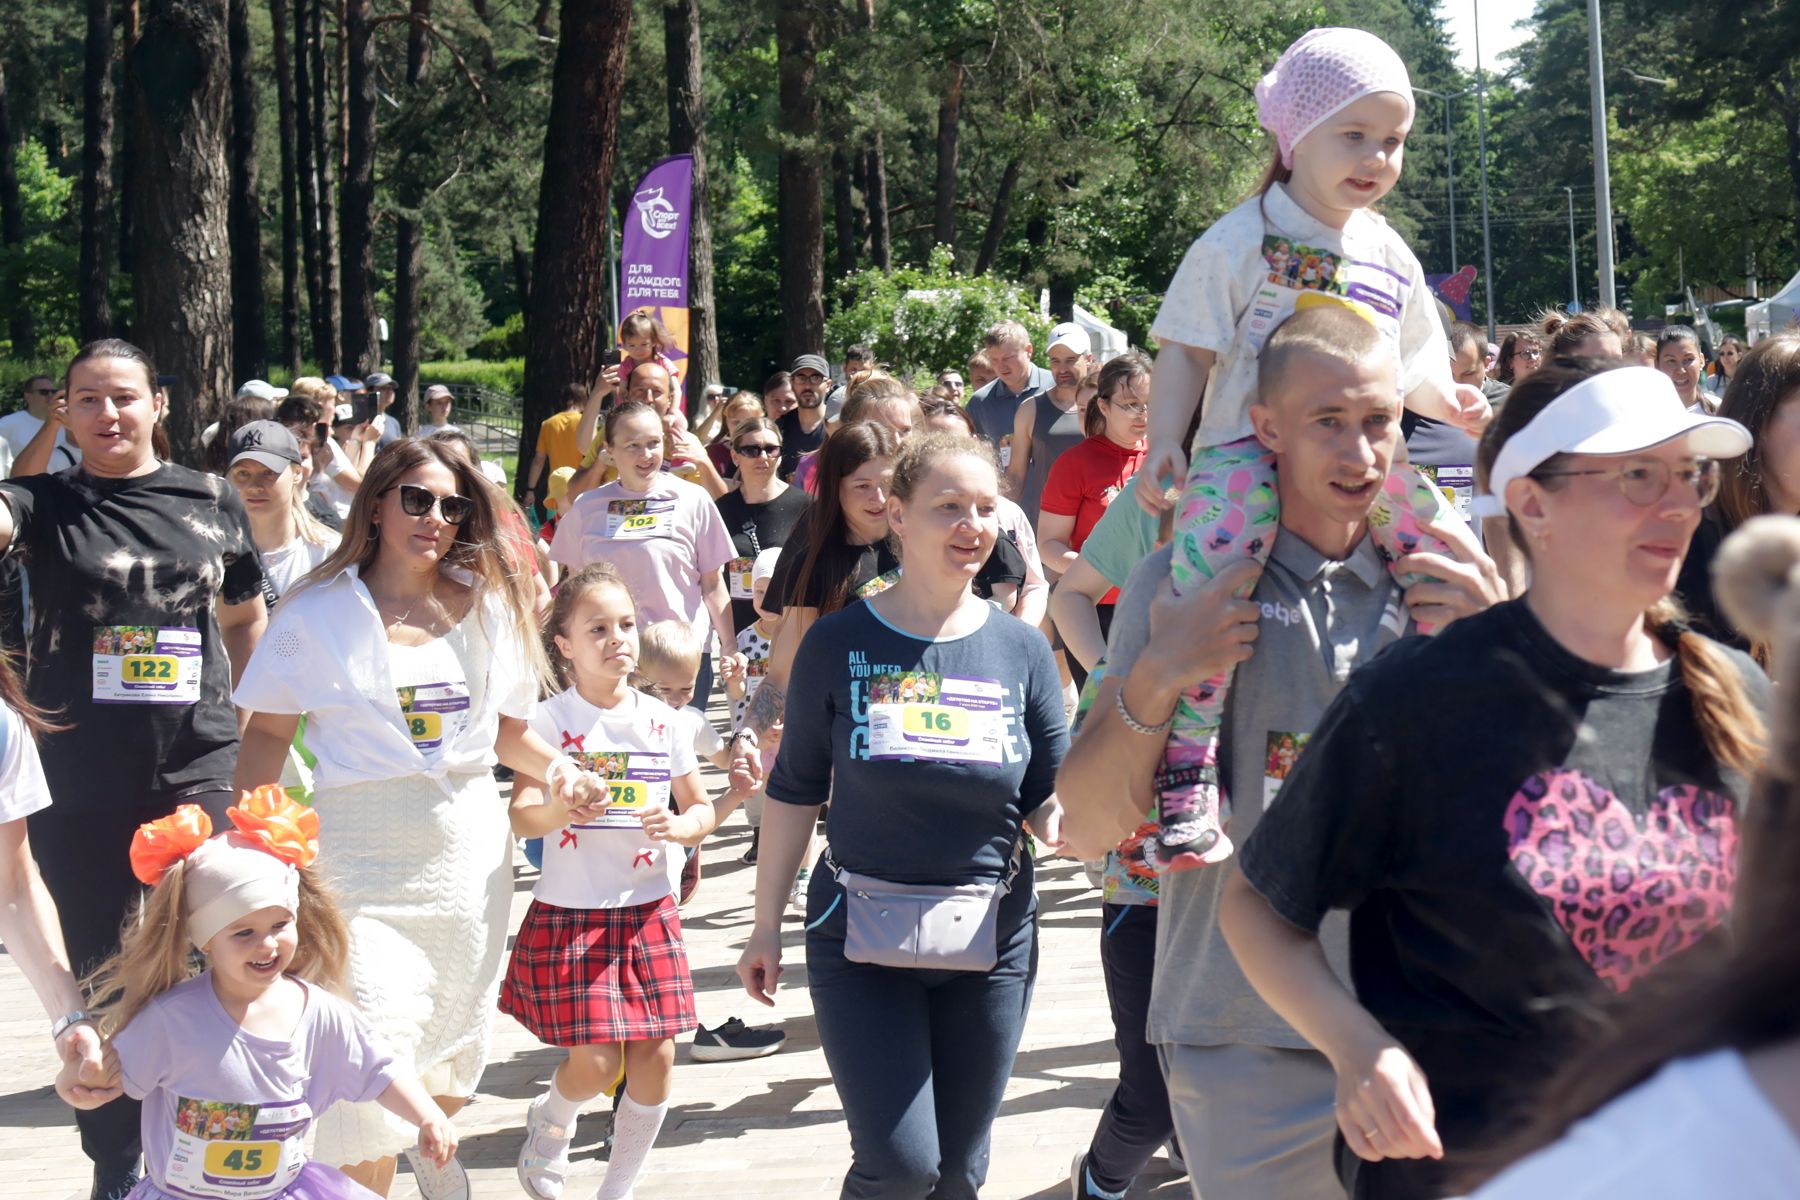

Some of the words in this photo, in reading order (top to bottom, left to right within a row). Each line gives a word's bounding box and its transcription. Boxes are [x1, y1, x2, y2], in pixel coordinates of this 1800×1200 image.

[653, 210, 680, 221] Спорт
[628, 264, 653, 274] ДЛЯ
[627, 287, 651, 298] ДЛЯ
[628, 516, 654, 527] 102
[849, 650, 867, 664] ALL
[130, 660, 172, 677] 122
[849, 664, 870, 678] YOU
[405, 718, 427, 736] 8
[921, 711, 952, 731] 16
[610, 786, 636, 803] 78
[223, 1149, 263, 1171] 45
